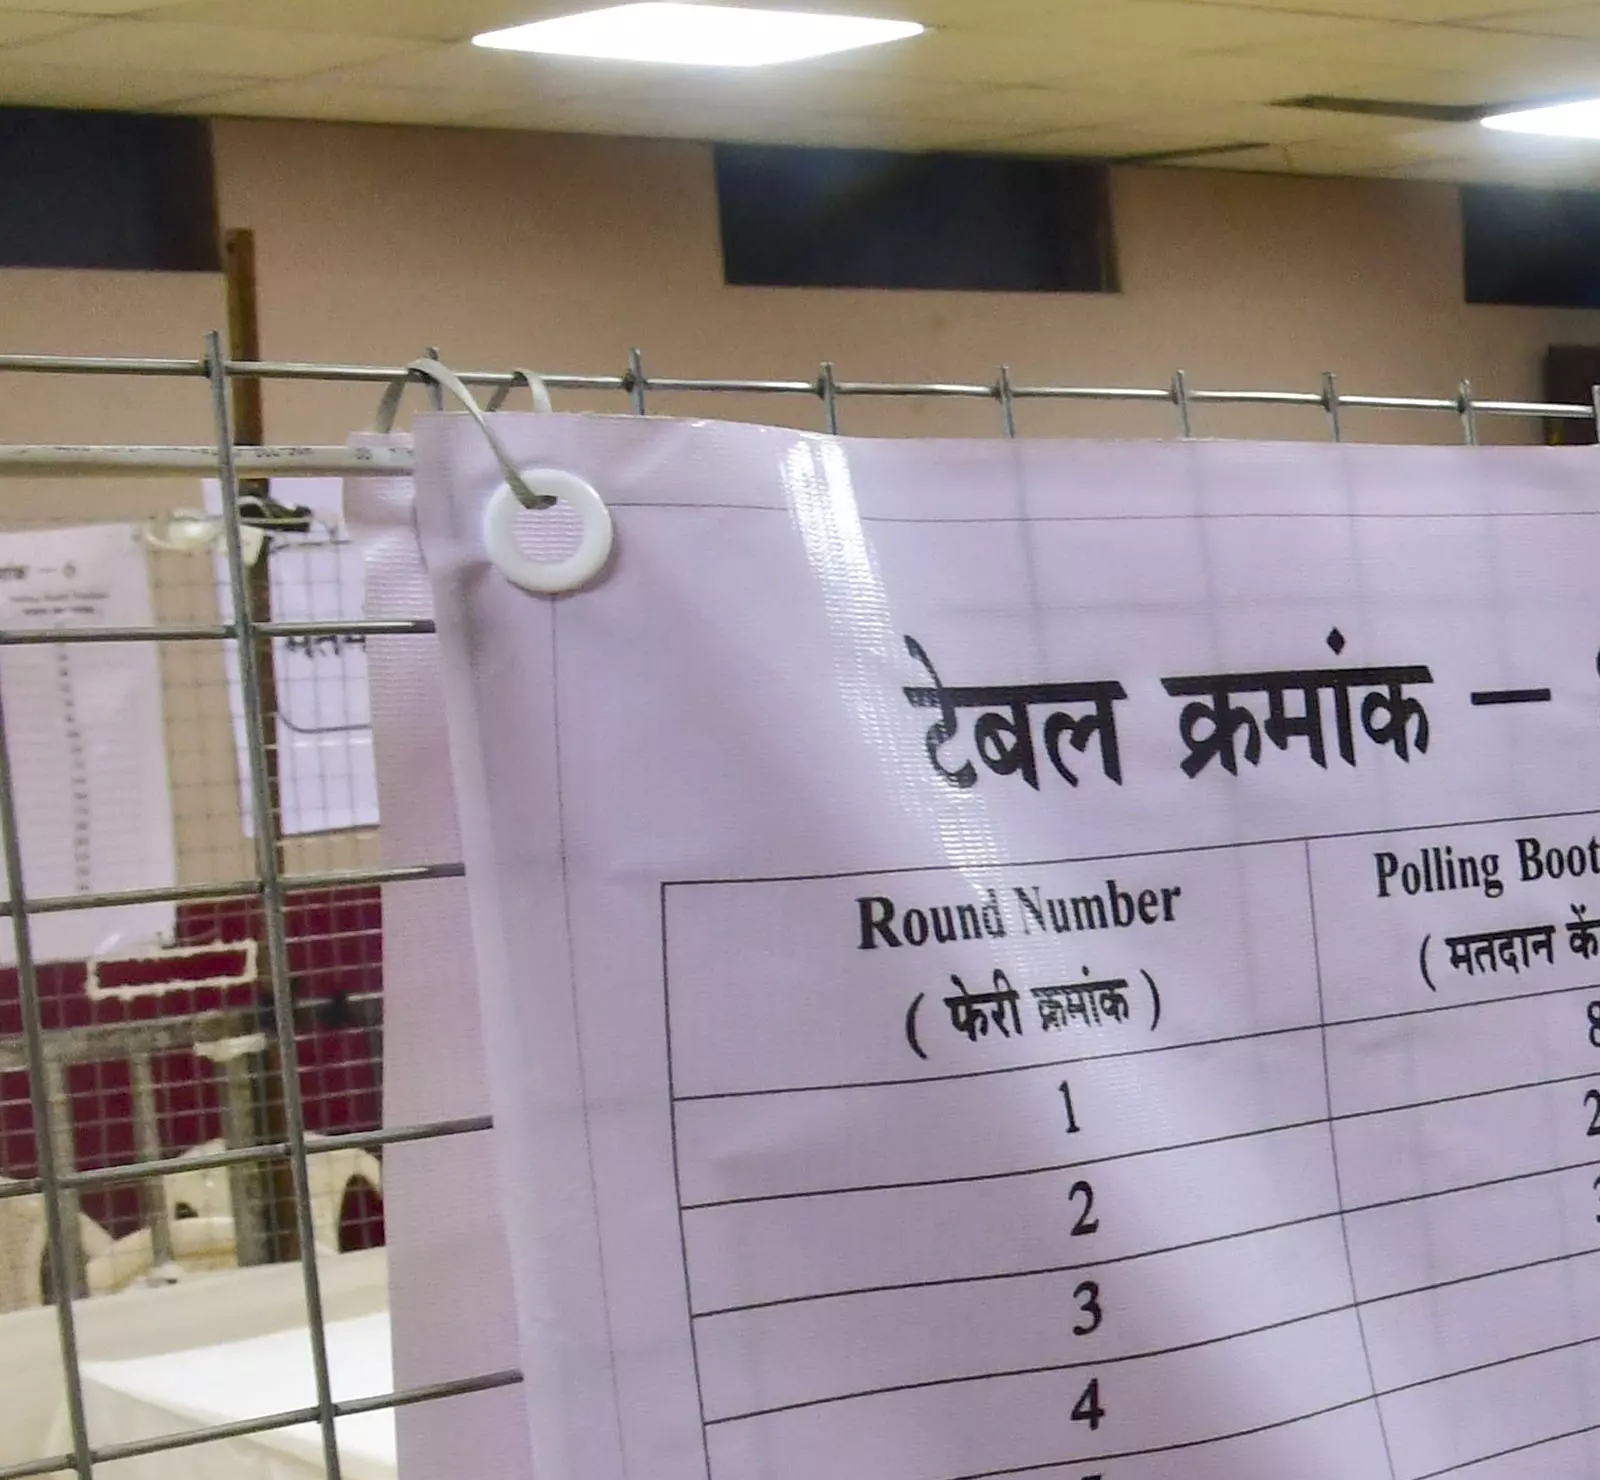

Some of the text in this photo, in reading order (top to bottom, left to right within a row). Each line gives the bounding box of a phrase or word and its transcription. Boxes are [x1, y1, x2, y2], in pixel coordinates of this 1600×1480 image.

[902, 635, 1128, 791] टेबल
[1160, 627, 1434, 779] क्रमांक
[1373, 846, 1504, 898] Polling
[855, 880, 1181, 949] Round Number
[1444, 925, 1556, 976] मतदान
[1030, 966, 1129, 1032] क्रमांक
[1059, 1081, 1080, 1133] 1
[1068, 1181, 1099, 1236] 2
[1073, 1281, 1102, 1336] 3
[1070, 1378, 1105, 1431] 4
